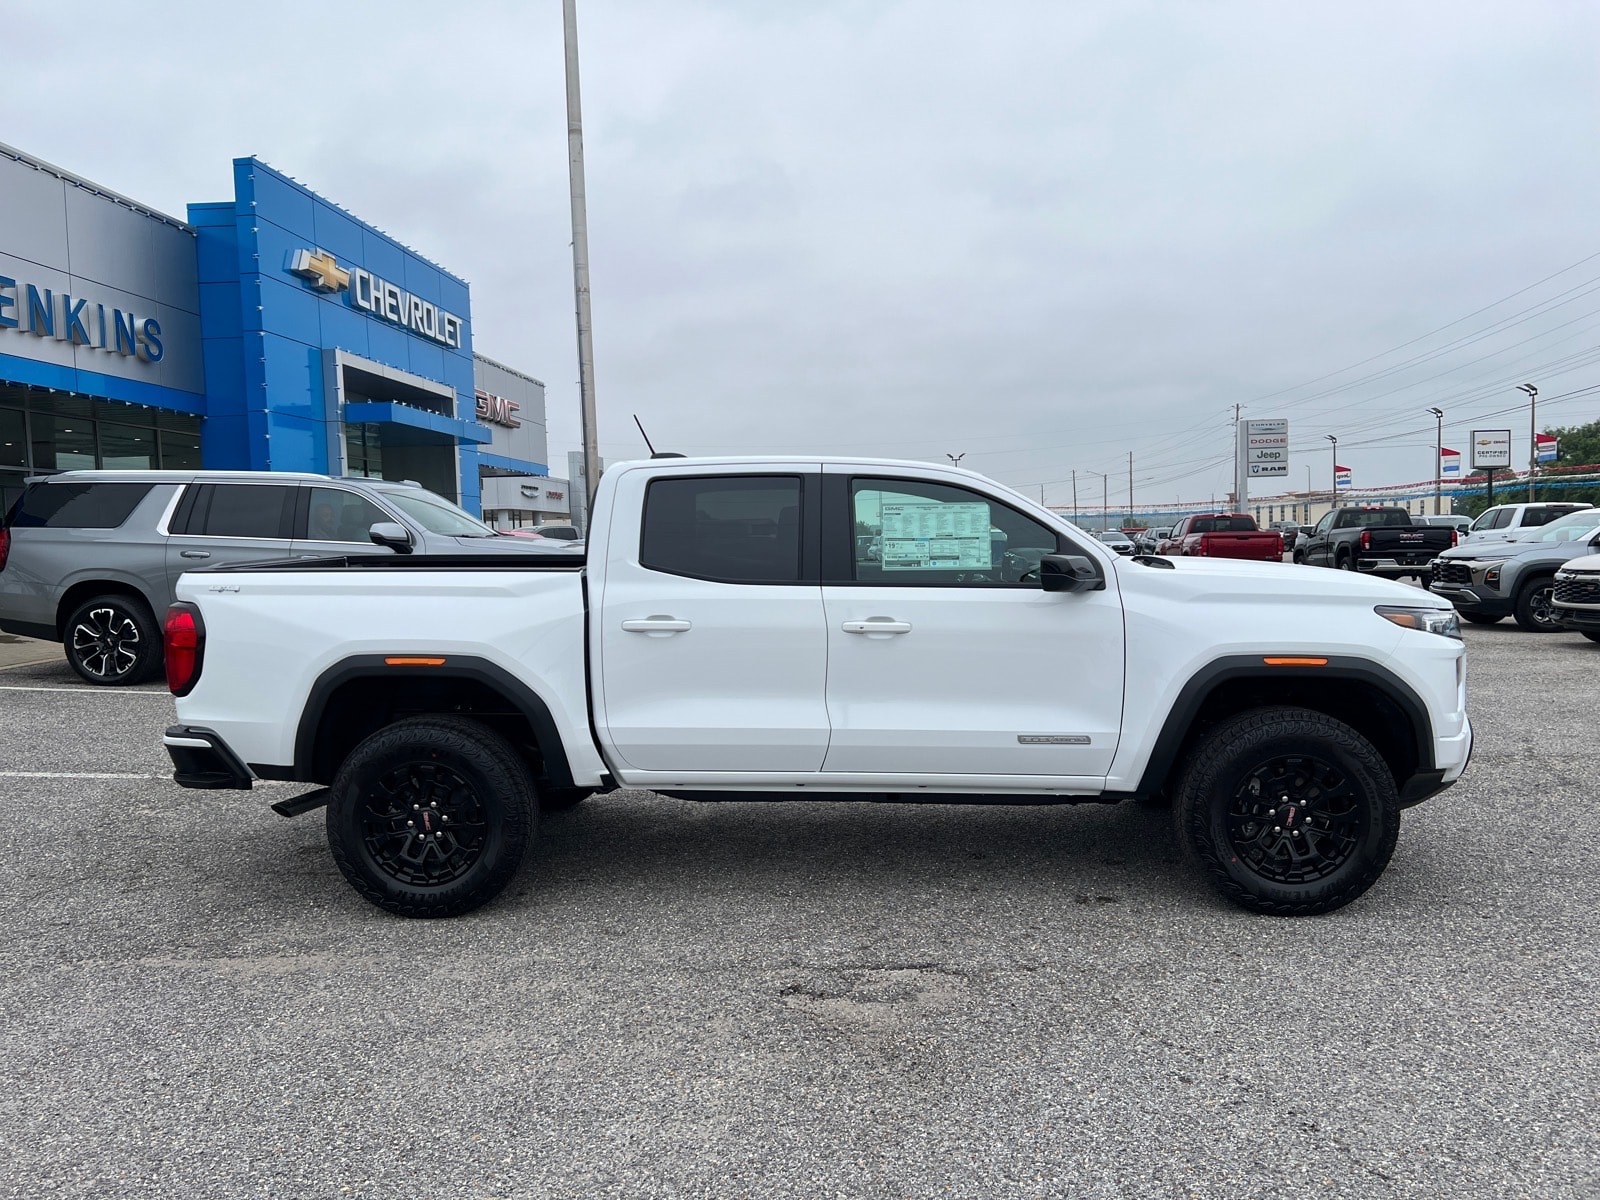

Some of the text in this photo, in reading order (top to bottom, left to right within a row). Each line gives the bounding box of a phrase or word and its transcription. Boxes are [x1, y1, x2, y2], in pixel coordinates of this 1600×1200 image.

[0, 275, 164, 362] ENKINS
[349, 267, 463, 349] CHEVROLET
[474, 388, 521, 429] GMC
[1256, 450, 1281, 460] Jeep
